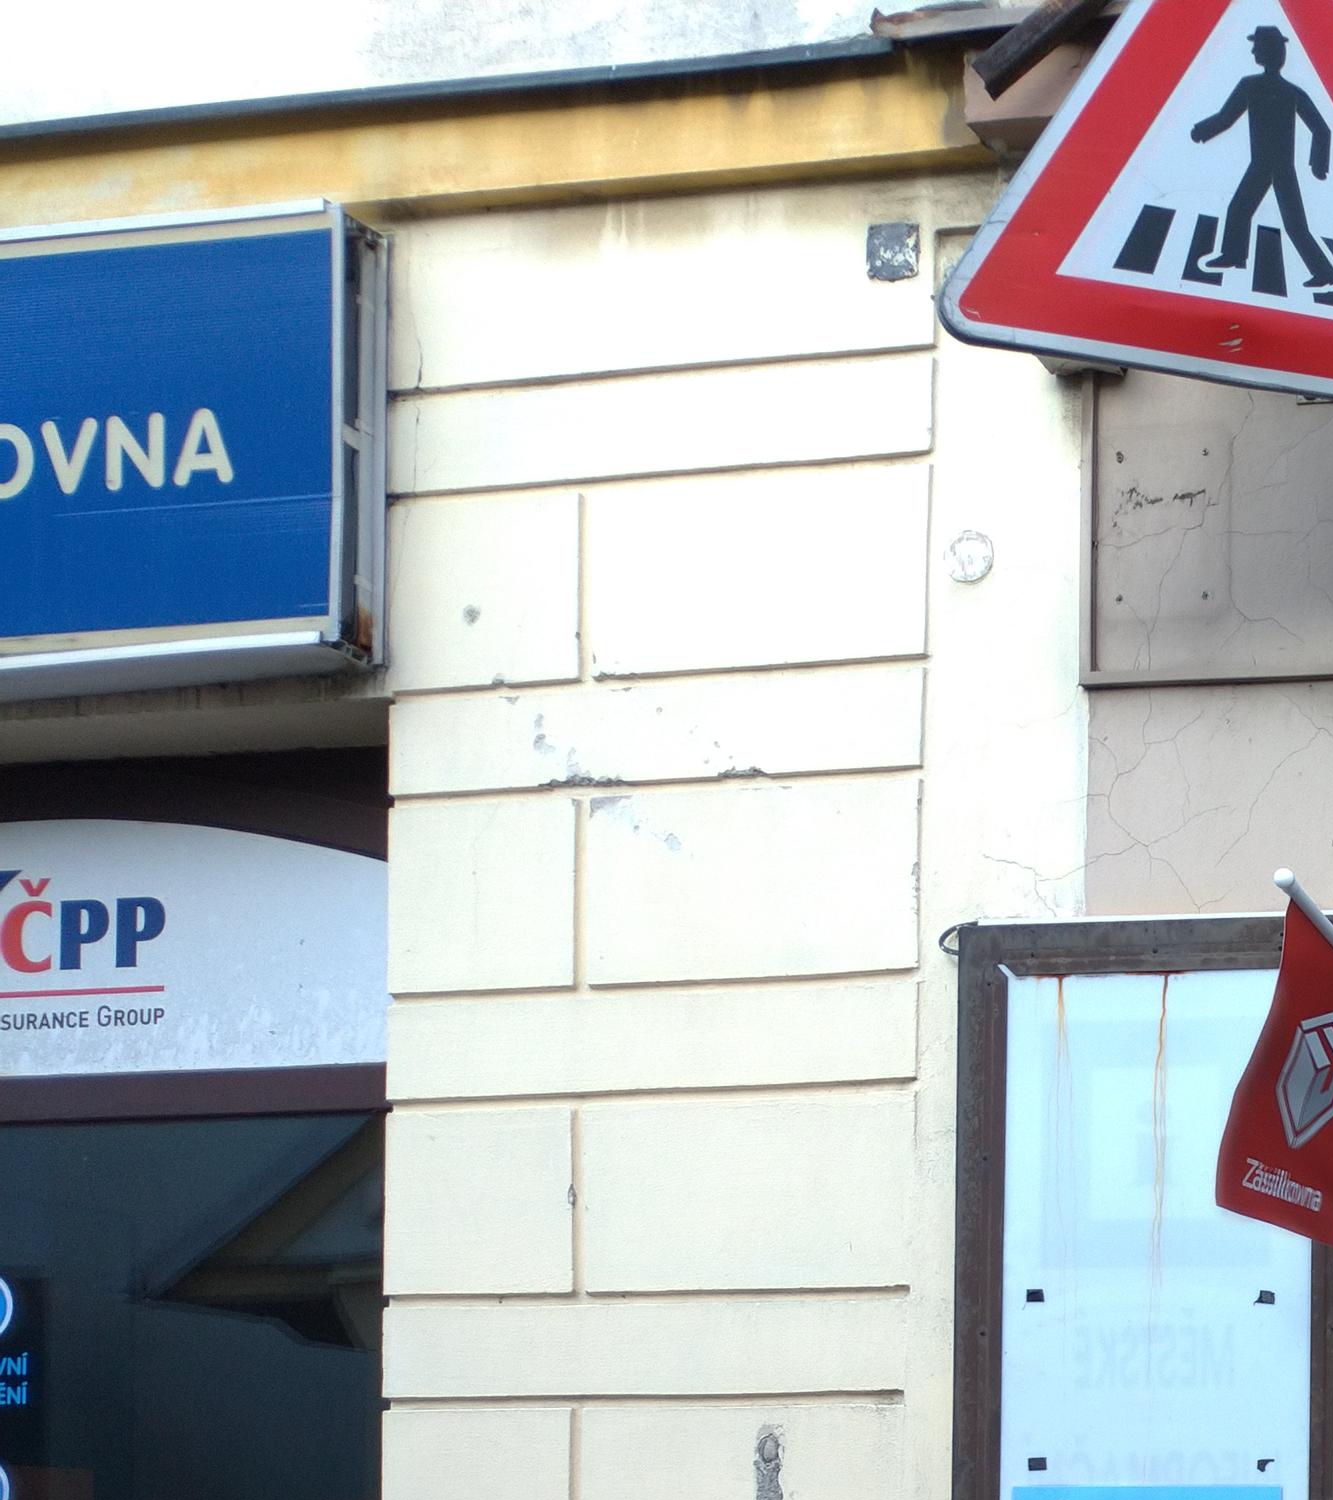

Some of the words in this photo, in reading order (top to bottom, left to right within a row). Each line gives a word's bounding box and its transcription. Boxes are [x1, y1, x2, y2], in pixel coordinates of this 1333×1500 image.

[1, 878, 166, 973] ČPP
[97, 1005, 165, 1028] GROUP
[1241, 1157, 1323, 1213] Zásilkovna
